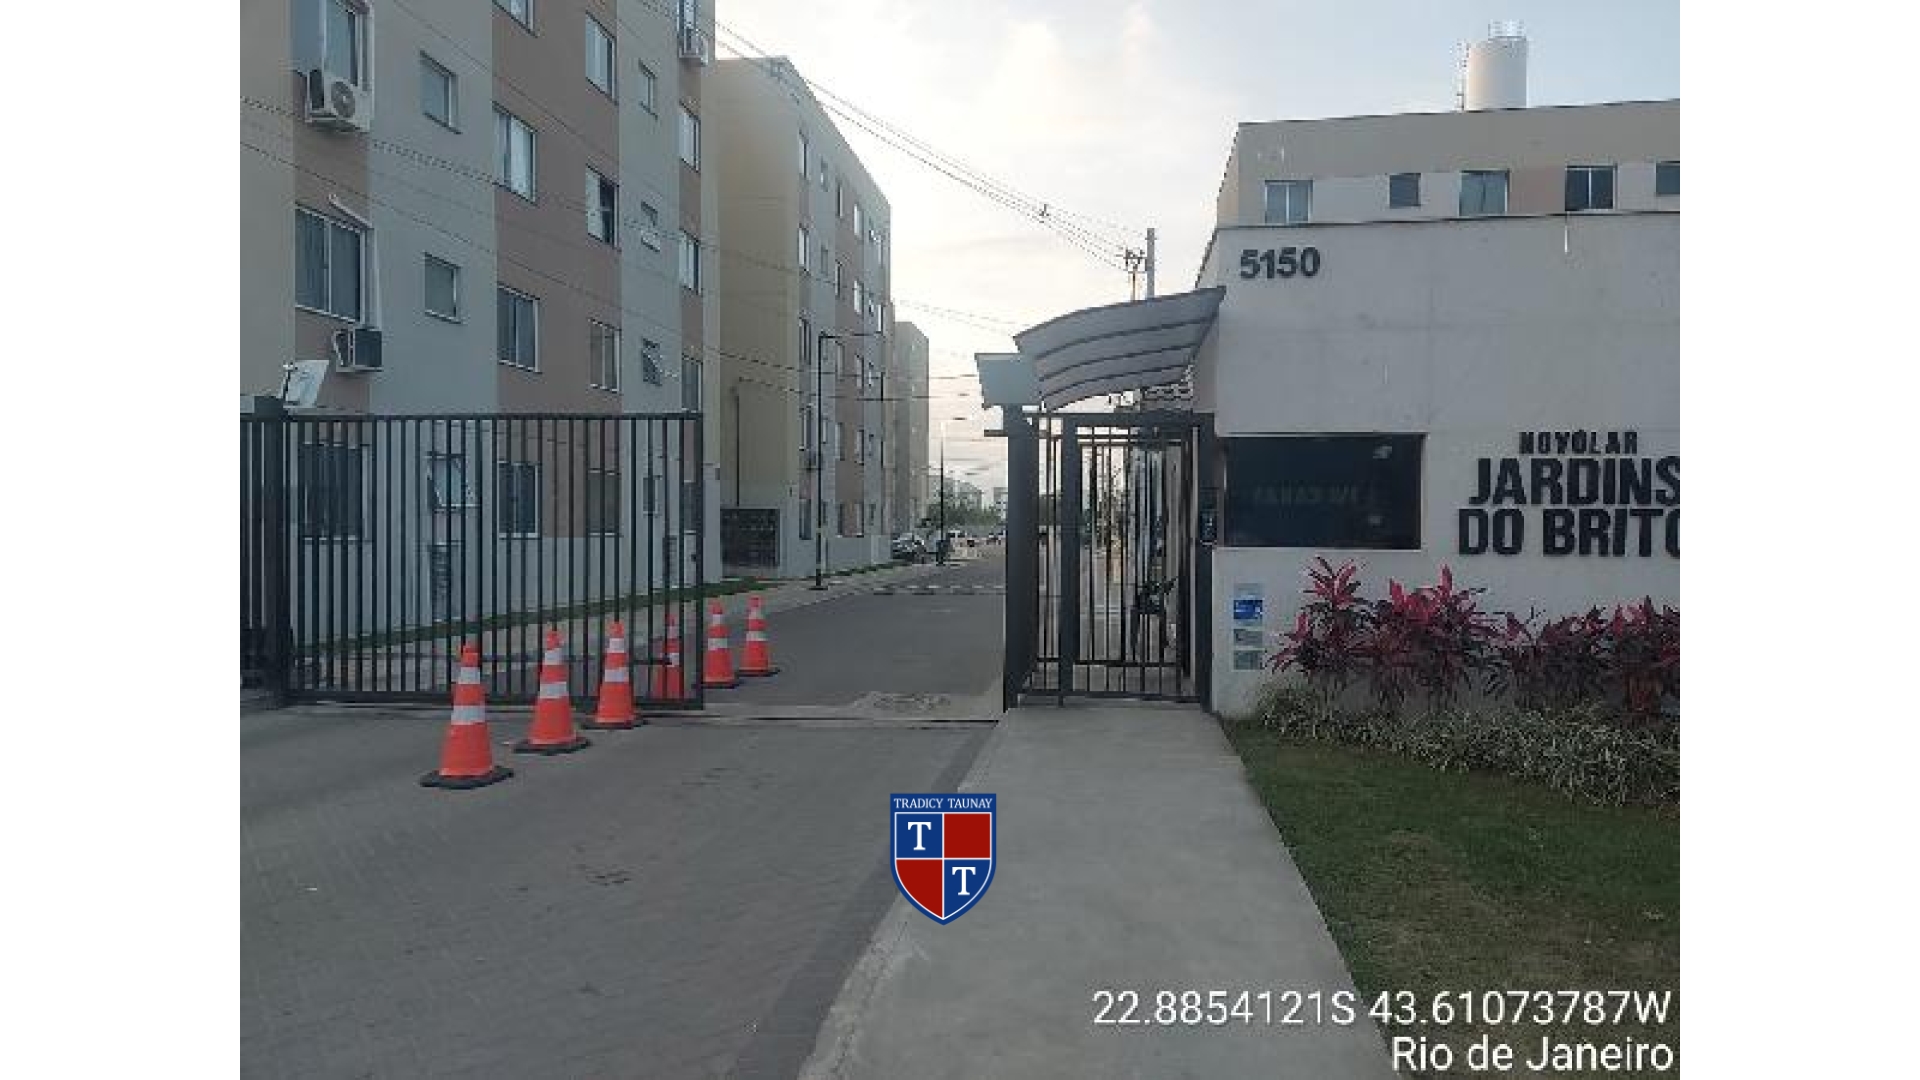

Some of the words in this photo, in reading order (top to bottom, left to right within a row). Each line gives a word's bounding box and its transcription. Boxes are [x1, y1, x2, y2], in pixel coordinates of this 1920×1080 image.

[1241, 246, 1321, 279] 5150
[1519, 429, 1638, 454] NOVOLAR
[1468, 456, 1680, 506] JARDINS
[1458, 508, 1525, 555] DO
